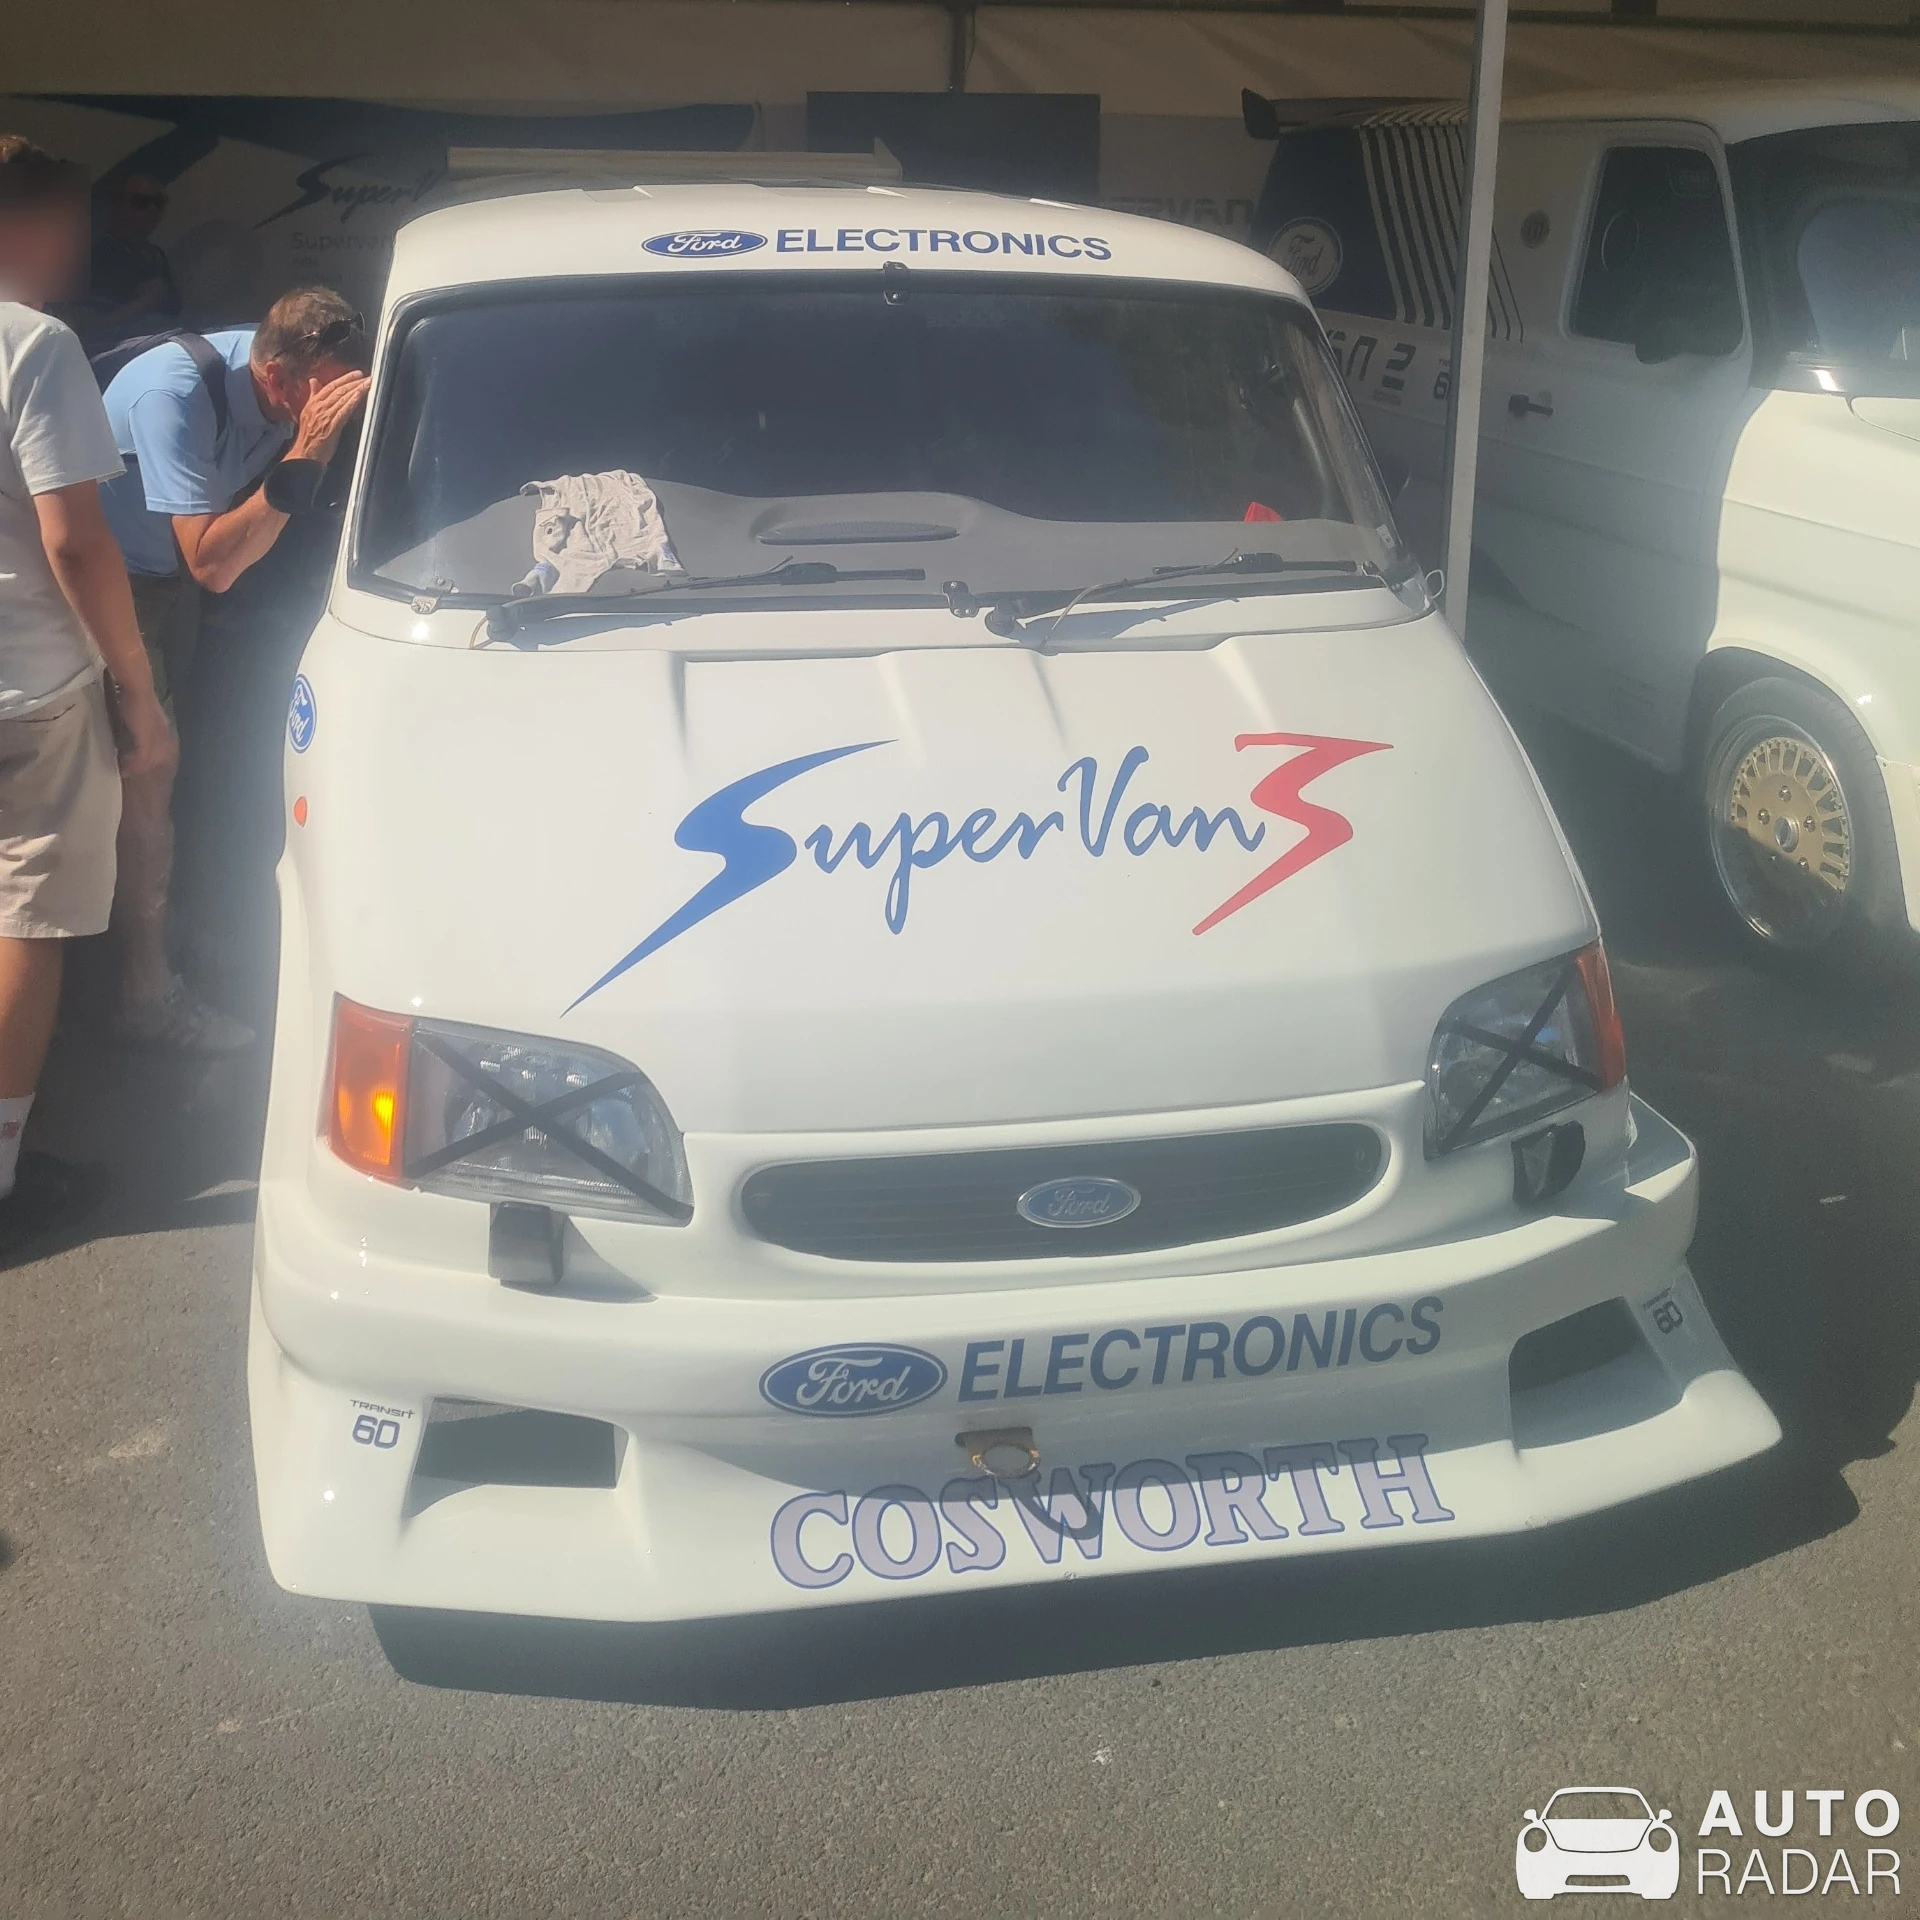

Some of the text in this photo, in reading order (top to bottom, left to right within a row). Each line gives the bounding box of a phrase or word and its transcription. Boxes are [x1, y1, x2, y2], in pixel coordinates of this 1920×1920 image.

[666, 228, 1112, 261] Ford ELECTRONICS
[1433, 371, 1449, 401] 6
[796, 1295, 1445, 1406] Ford ELECTRONICS
[349, 1399, 416, 1420] TRANSIT
[352, 1414, 401, 1449] 60
[770, 1433, 1456, 1590] COSWORTH
